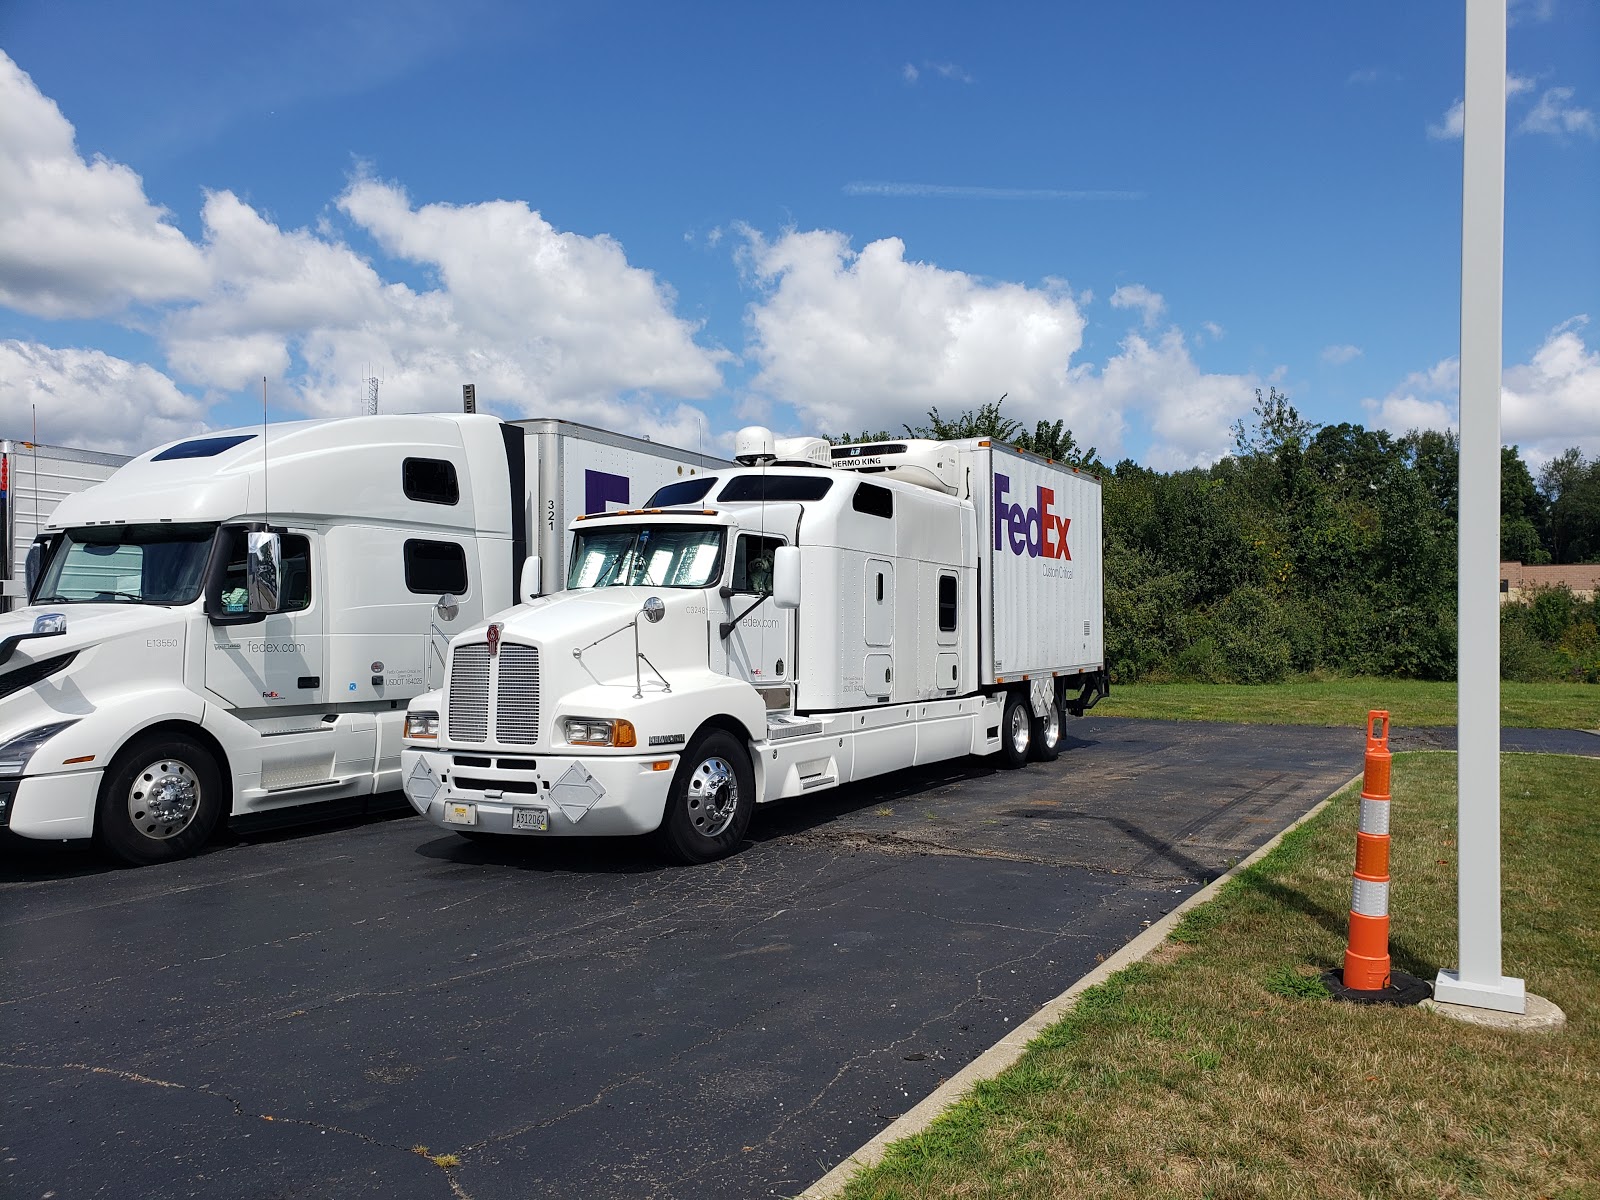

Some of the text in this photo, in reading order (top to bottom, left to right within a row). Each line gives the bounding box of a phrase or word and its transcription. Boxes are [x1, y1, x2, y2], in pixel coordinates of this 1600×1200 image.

[832, 457, 881, 469] HERMO KING
[547, 500, 555, 531] 321
[994, 472, 1072, 561] FedEx
[685, 606, 706, 615] C3248
[742, 615, 780, 629] edex.com
[146, 639, 178, 648] E13550
[247, 640, 306, 653] fedex.com
[516, 813, 545, 826] A312062
